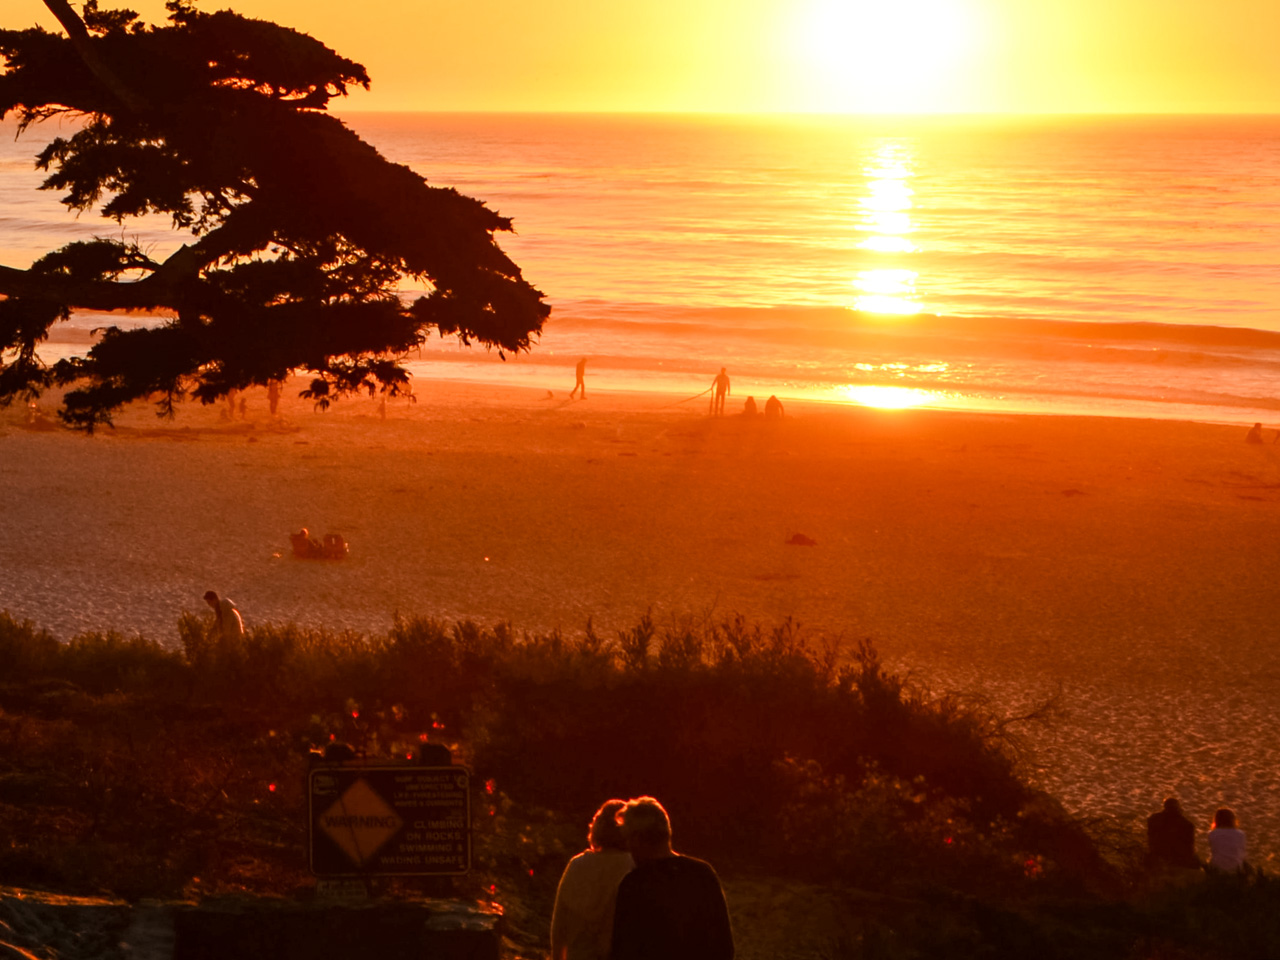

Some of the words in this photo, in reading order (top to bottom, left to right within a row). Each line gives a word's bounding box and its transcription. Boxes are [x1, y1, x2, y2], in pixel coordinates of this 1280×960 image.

[325, 815, 396, 828] WARNING
[413, 820, 464, 829] CLIMBING
[407, 832, 421, 841] ON
[399, 843, 453, 853] SWIMMING
[380, 855, 421, 865] WADING
[425, 855, 464, 864] UNSAFE
